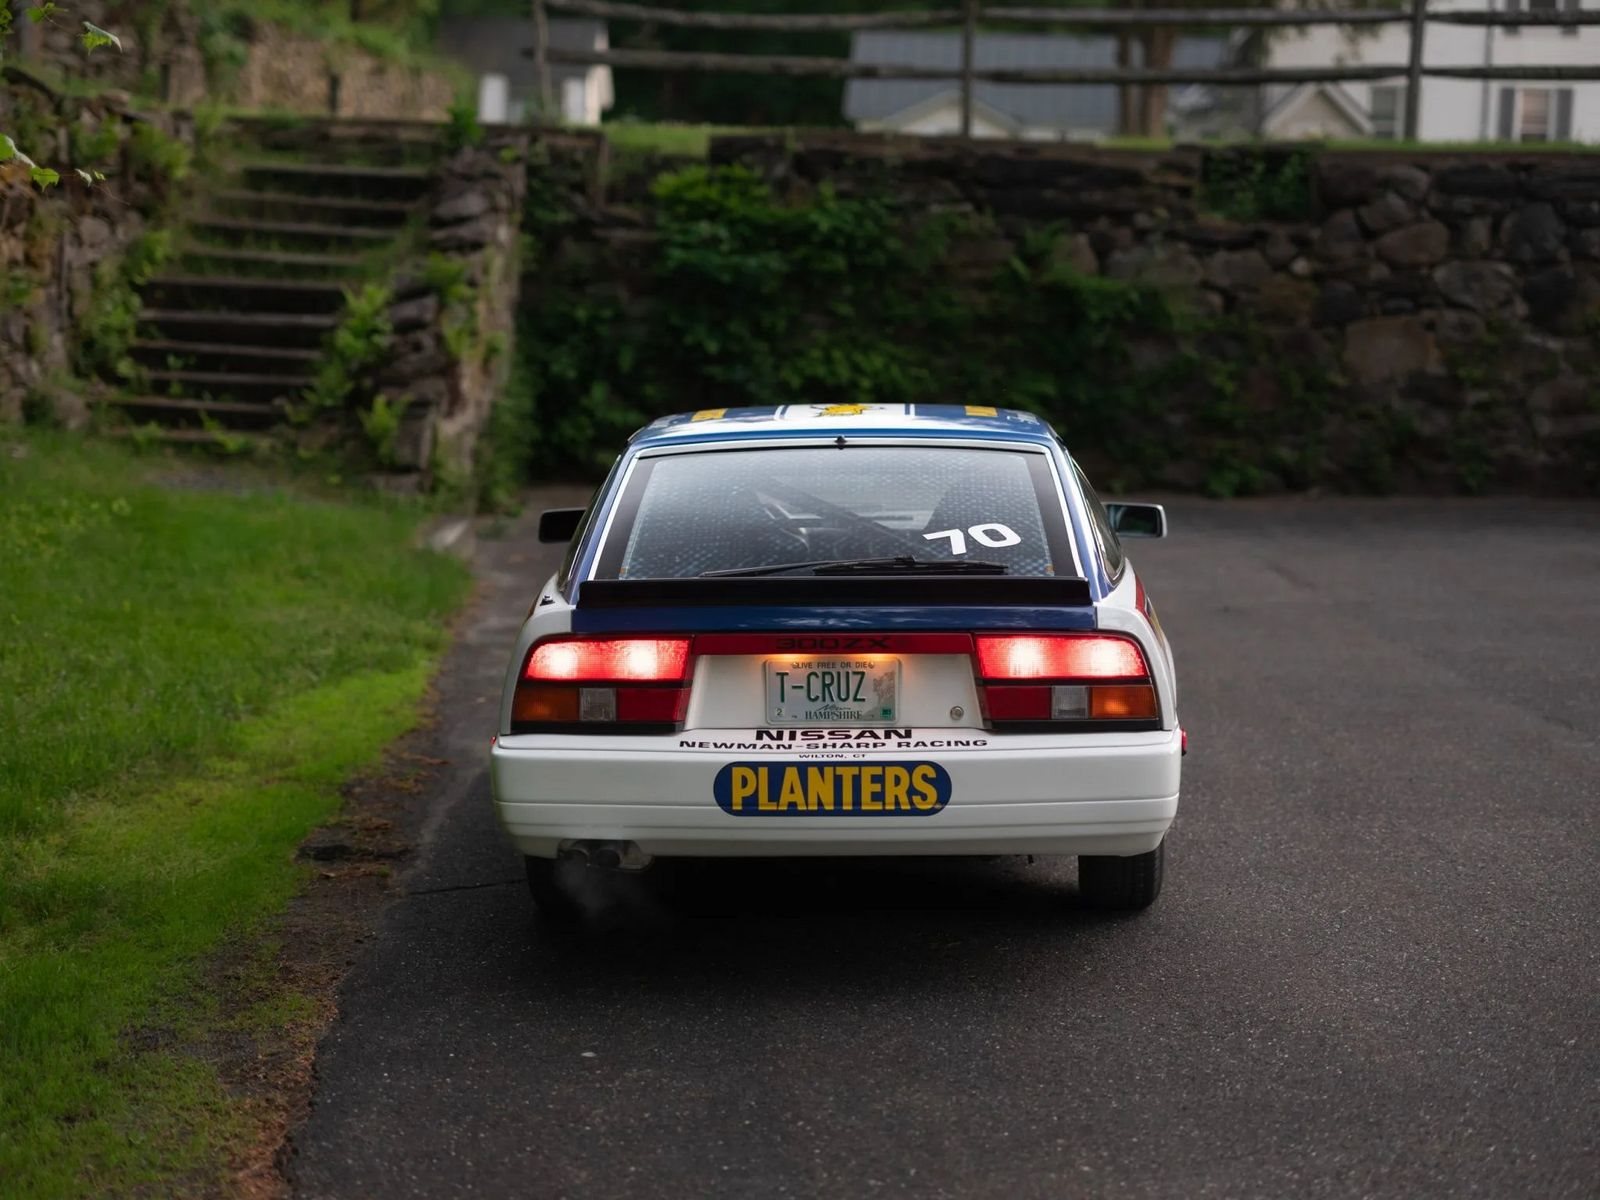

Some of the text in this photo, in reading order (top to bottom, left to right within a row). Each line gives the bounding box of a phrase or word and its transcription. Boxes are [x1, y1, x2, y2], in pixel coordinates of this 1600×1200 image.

[922, 523, 1021, 555] 70
[776, 637, 890, 650] 300ZX
[776, 671, 866, 703] T-CRUZ
[805, 710, 863, 720] HAMPSHIRE
[756, 729, 912, 741] NISSAN
[679, 739, 988, 750] NEWMAN-SHARP RACING
[732, 764, 938, 810] PLANTERS
